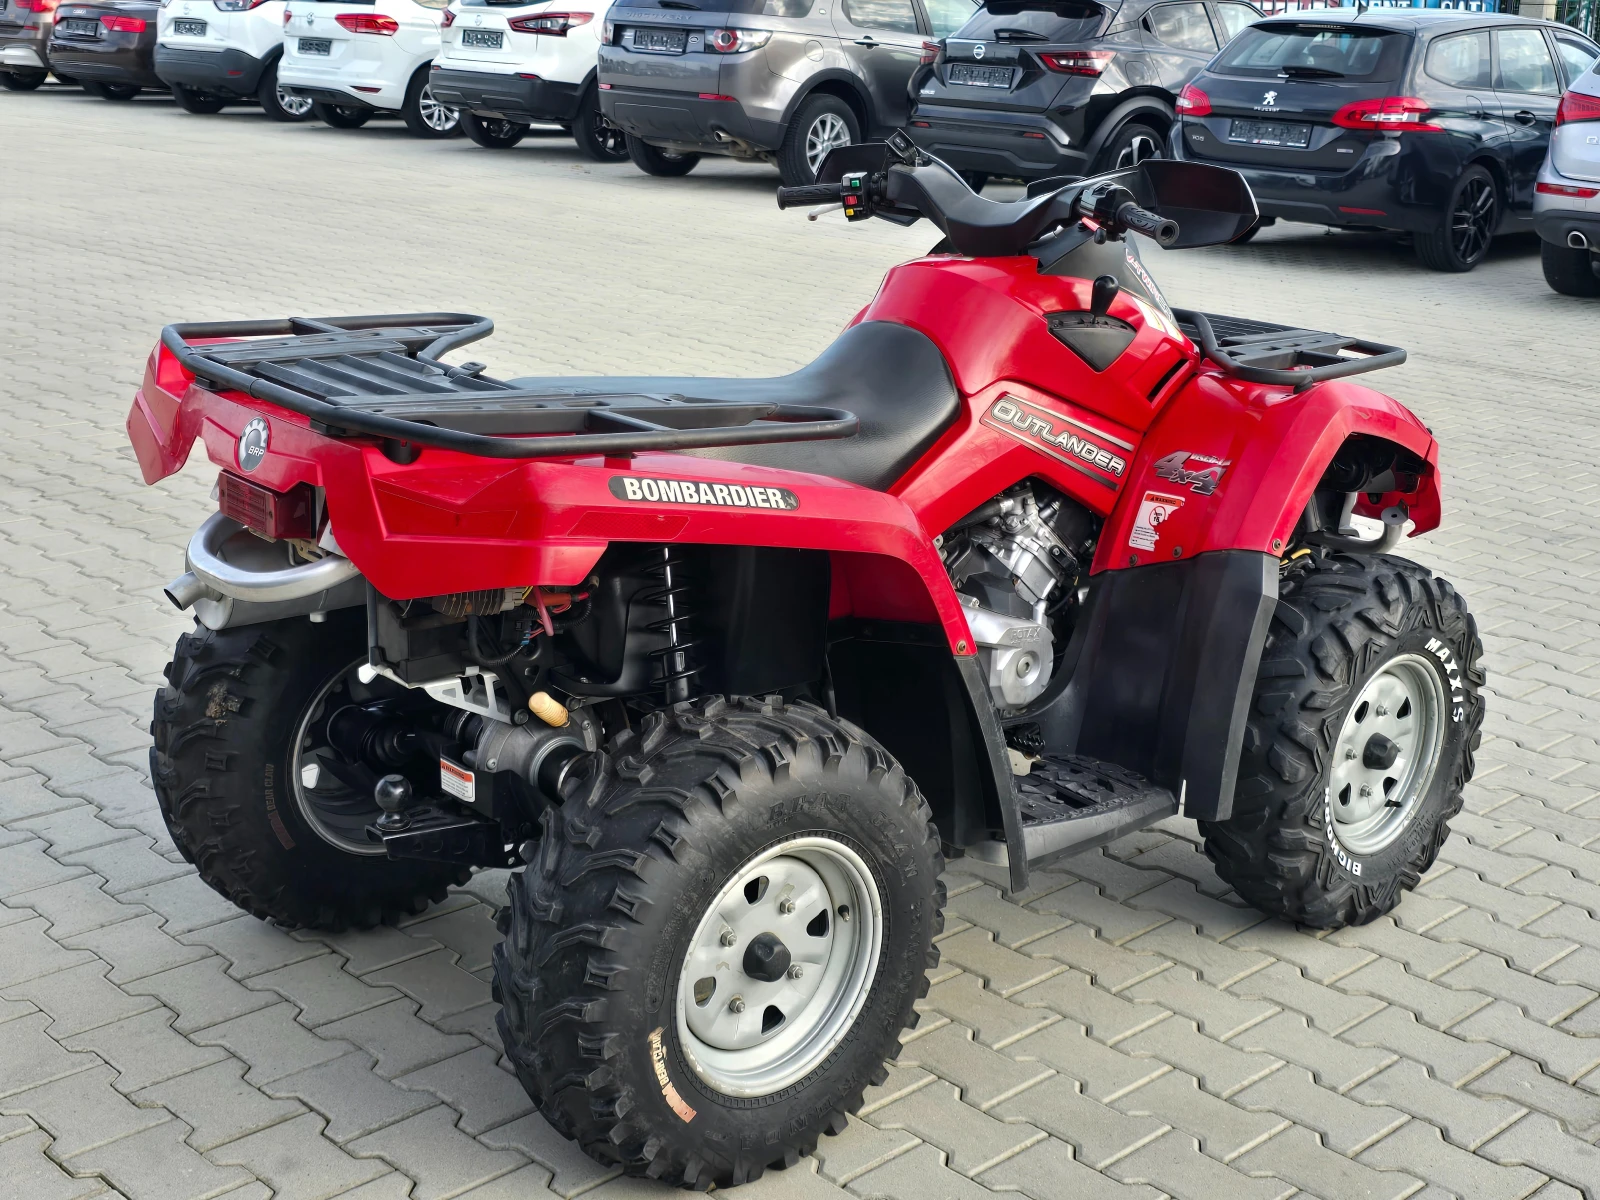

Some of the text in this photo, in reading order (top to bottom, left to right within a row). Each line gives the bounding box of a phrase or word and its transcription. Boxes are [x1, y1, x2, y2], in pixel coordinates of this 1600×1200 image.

[248, 445, 265, 457] BRP
[991, 399, 1127, 478] OUTLANDER
[622, 477, 787, 510] BOMBARDIER
[1424, 637, 1463, 723] MAXXIS
[654, 1059, 670, 1088] BEAR
